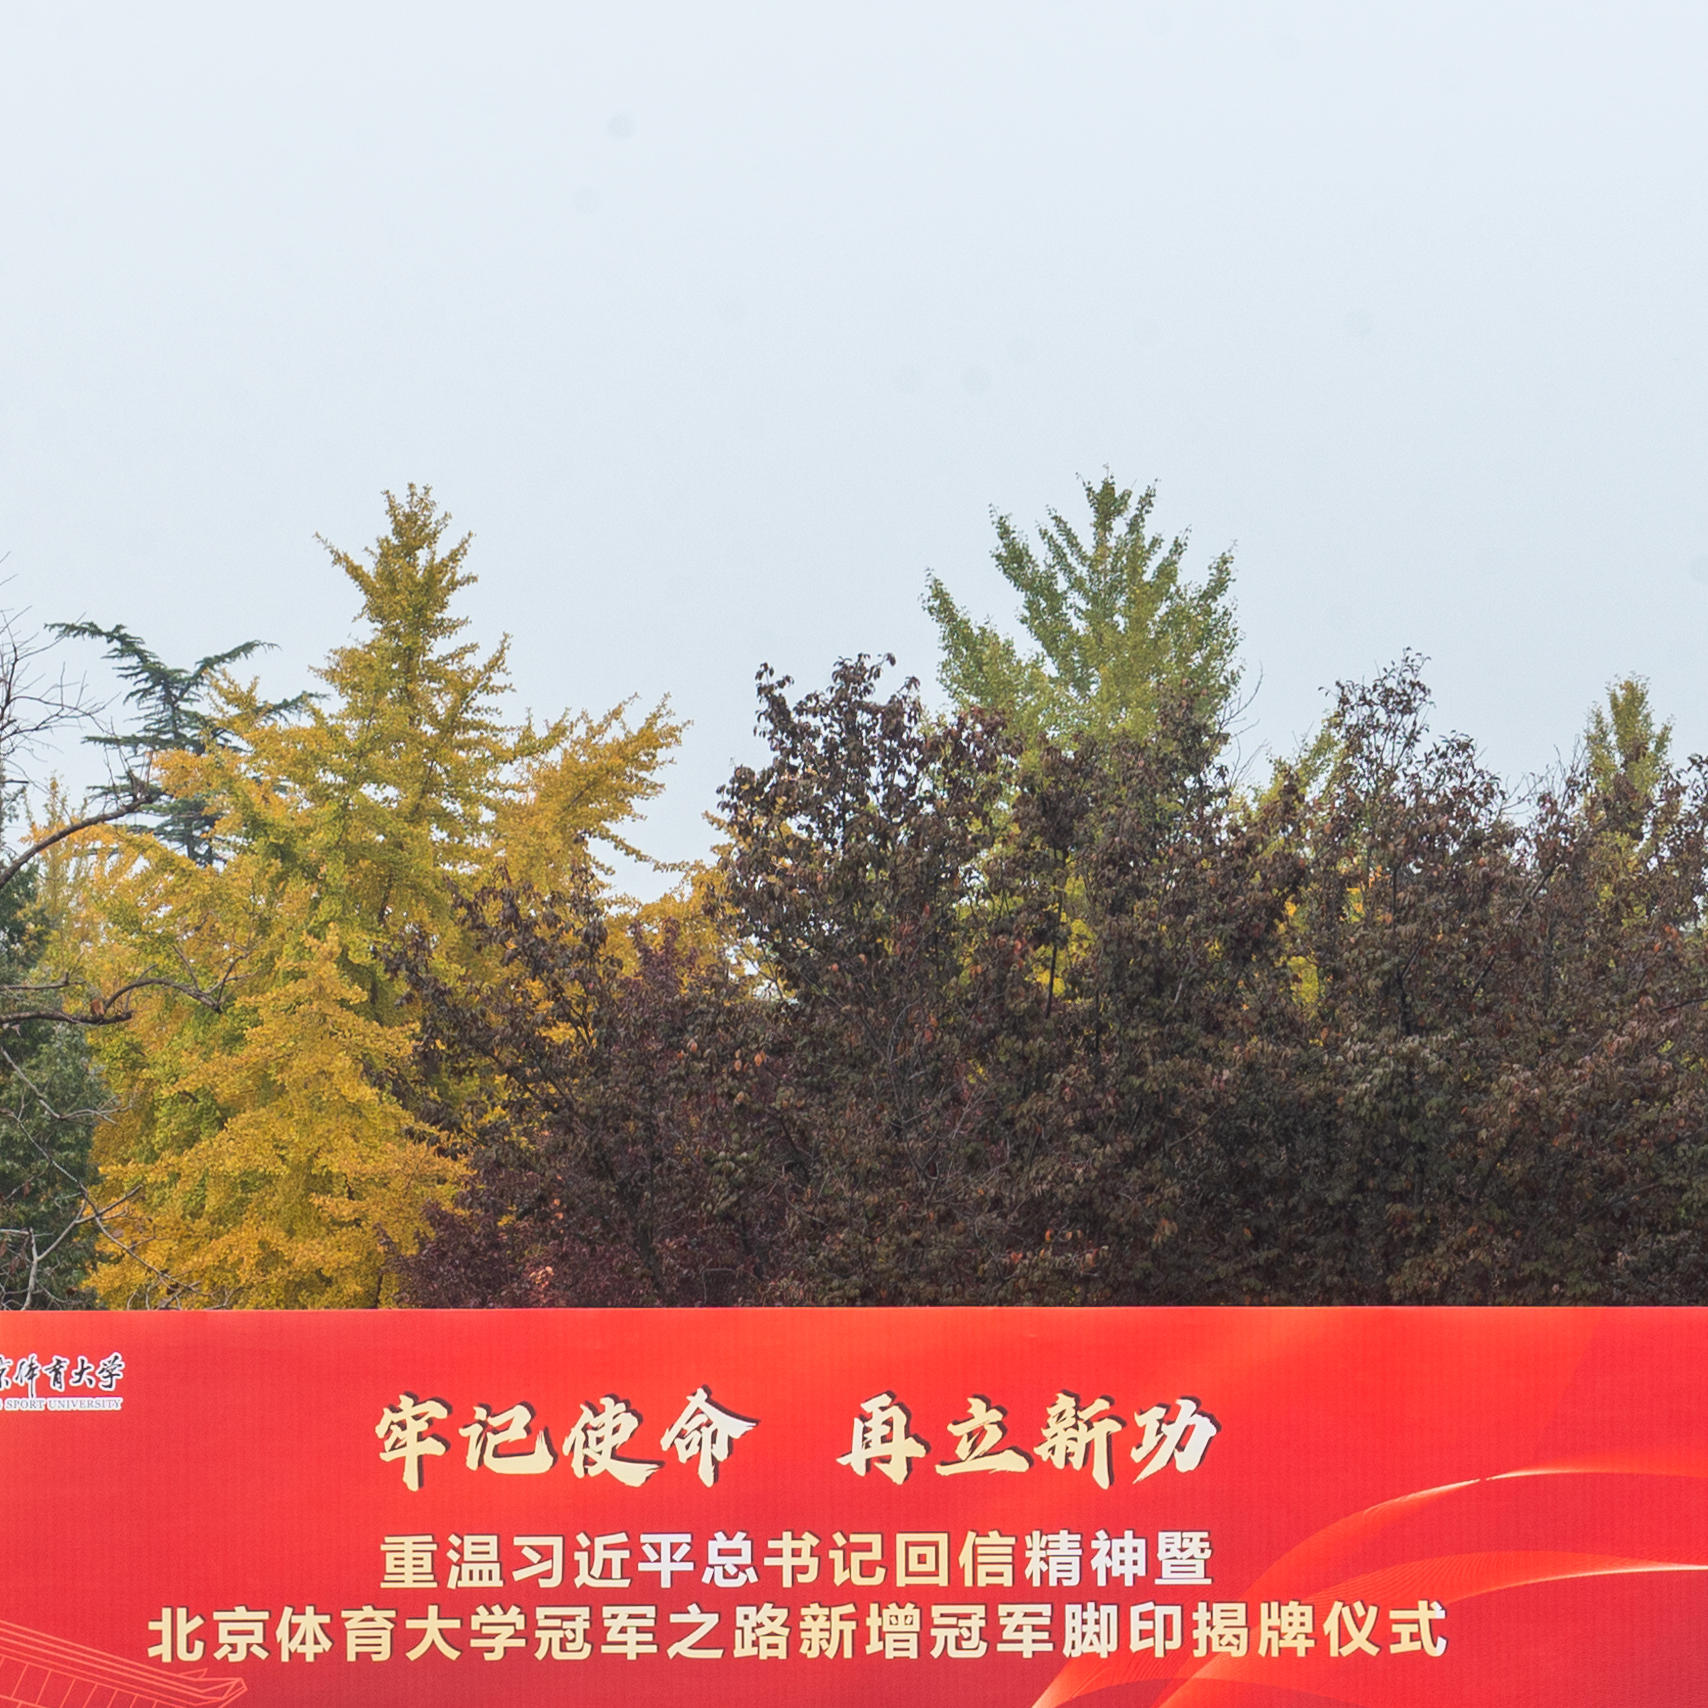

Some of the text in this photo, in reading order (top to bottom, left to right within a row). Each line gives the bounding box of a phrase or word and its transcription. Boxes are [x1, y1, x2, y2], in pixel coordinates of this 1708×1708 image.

[6, 1400, 45, 1410] SPORT
[49, 1399, 122, 1410] UNIVERSITY
[376, 1388, 1216, 1491] 牢记使命 再立新功
[380, 1529, 1213, 1590] 重温习近平总书记回信精神暨
[147, 1600, 1447, 1663] 北京体育大学冠军之路新增冠军脚印揭牌仪式
